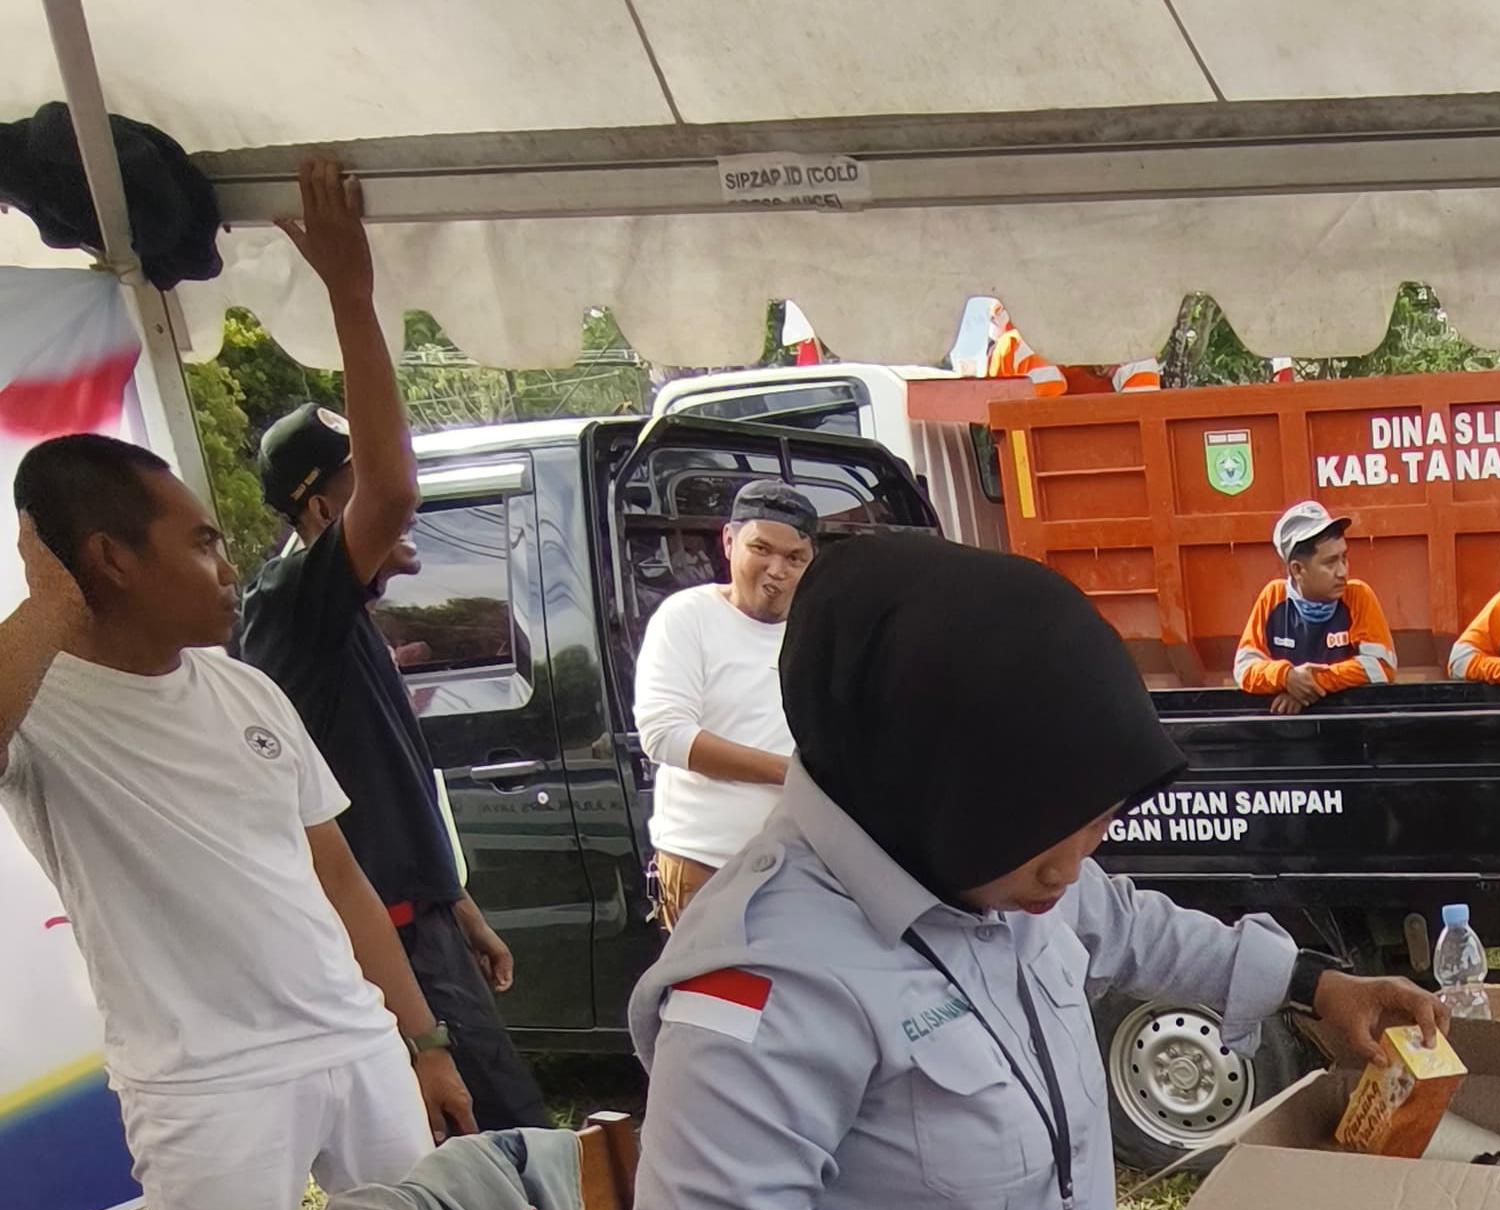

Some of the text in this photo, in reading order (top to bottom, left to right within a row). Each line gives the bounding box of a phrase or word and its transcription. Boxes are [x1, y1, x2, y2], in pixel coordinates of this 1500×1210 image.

[1127, 789, 1344, 816] KUTAN SAMPAH
[1102, 818, 1249, 842] GAN HIDUP
